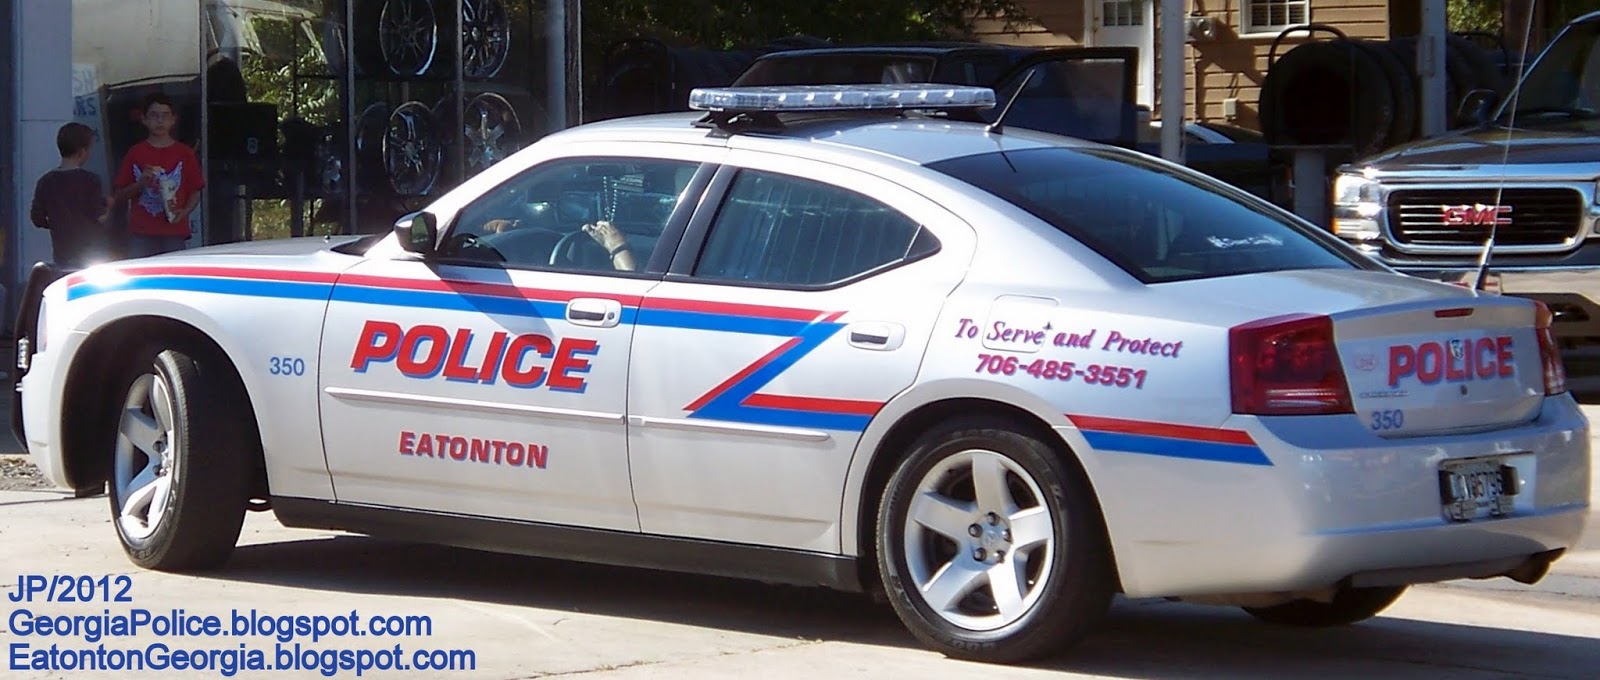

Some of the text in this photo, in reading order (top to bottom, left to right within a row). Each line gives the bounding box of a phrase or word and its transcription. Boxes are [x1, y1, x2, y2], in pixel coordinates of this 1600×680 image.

[1443, 205, 1513, 225] GMC
[350, 319, 600, 394] POLICE
[955, 318, 1184, 359] To Serve and Protect
[269, 356, 306, 377] 350
[975, 352, 1148, 390] 706-485-3551
[1387, 336, 1516, 389] POLICE
[1370, 408, 1404, 431] 350
[398, 431, 549, 469] EATONTON
